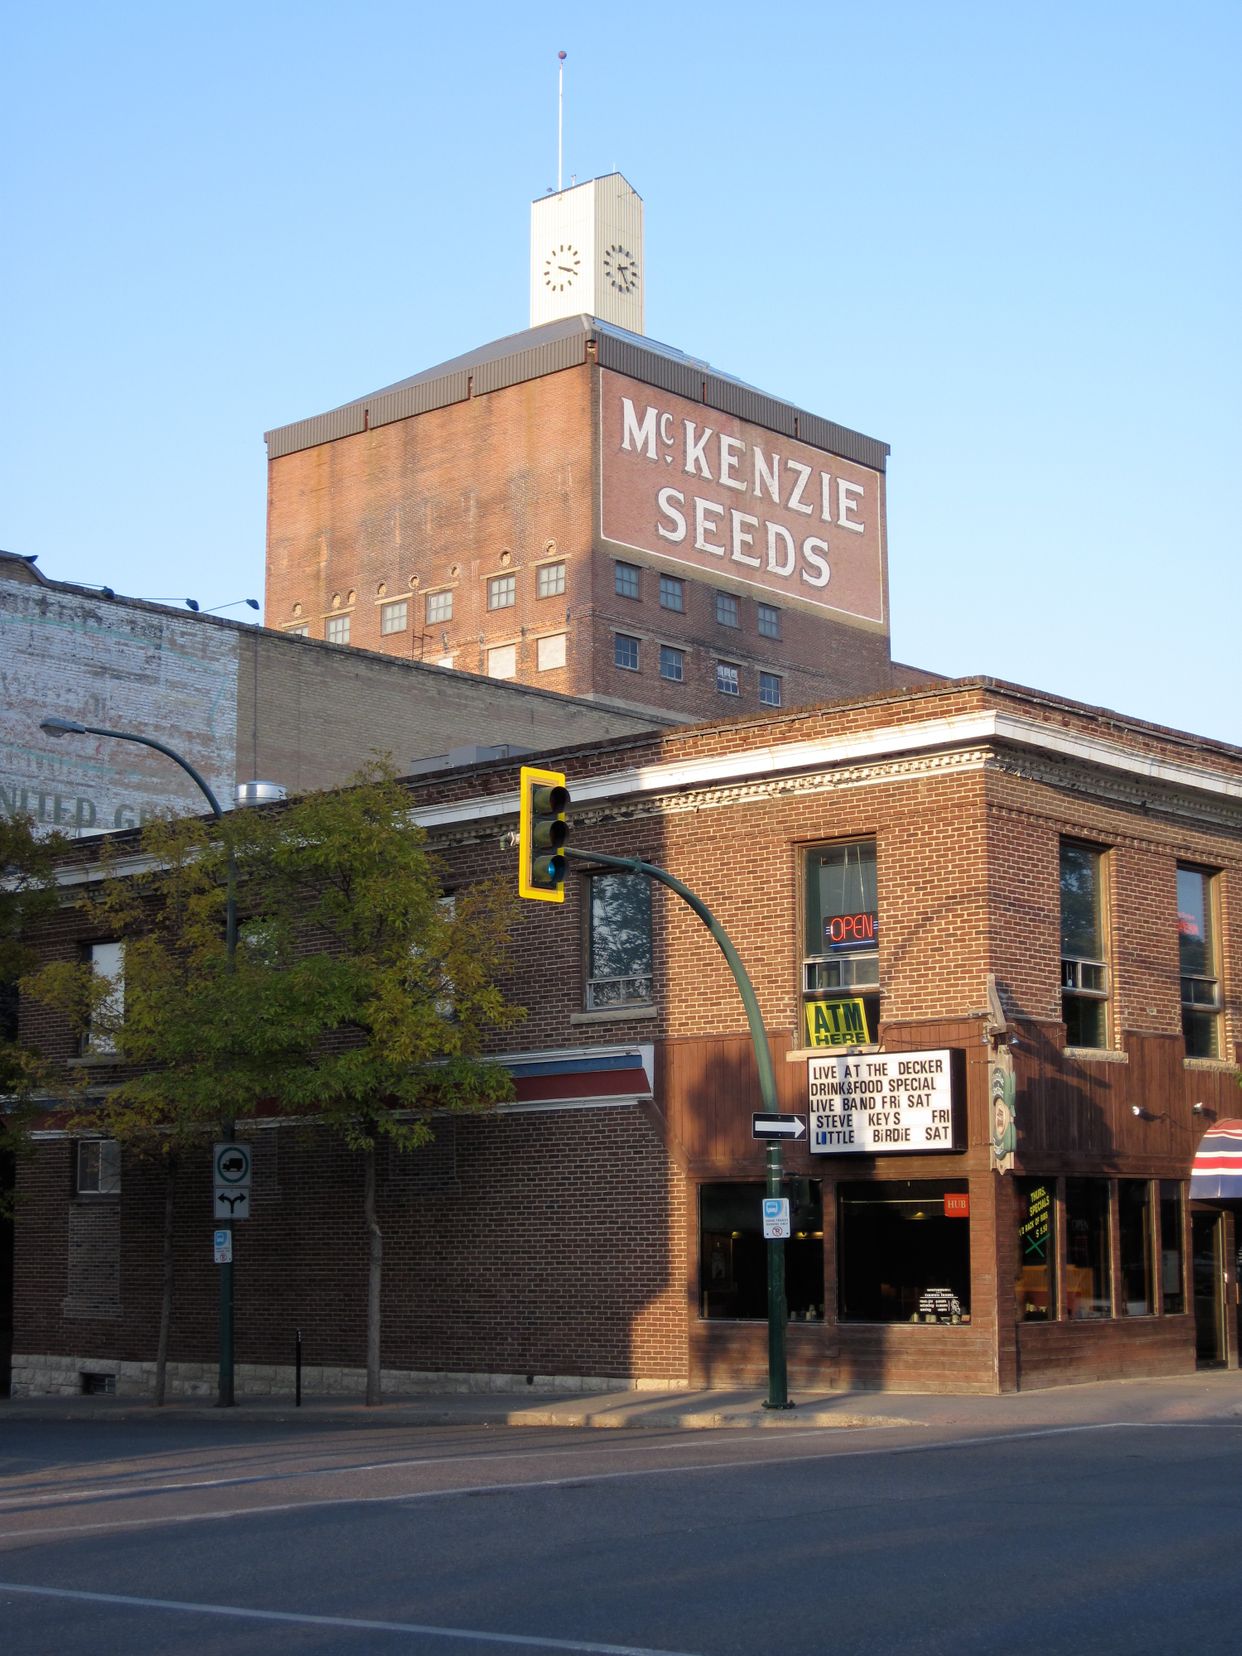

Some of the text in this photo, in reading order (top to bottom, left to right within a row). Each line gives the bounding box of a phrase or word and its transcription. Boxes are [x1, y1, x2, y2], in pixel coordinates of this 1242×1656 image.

[657, 487, 831, 588] SEEDS
[830, 914, 874, 942] OPEN
[814, 1002, 864, 1034] ATM
[815, 1032, 866, 1046] HERE
[813, 1059, 943, 1080] LIVE AT THE DECKER
[888, 1076, 936, 1092] SPECIAL
[810, 1098, 834, 1113] LIVE
[842, 1096, 876, 1111] BAND
[907, 1093, 932, 1108] SAT
[816, 1109, 950, 1129] STEVE KEYS FRI
[925, 1125, 949, 1141] SAT
[947, 1199, 966, 1209] HUB
[1029, 1195, 1050, 1217] SPECIALS
